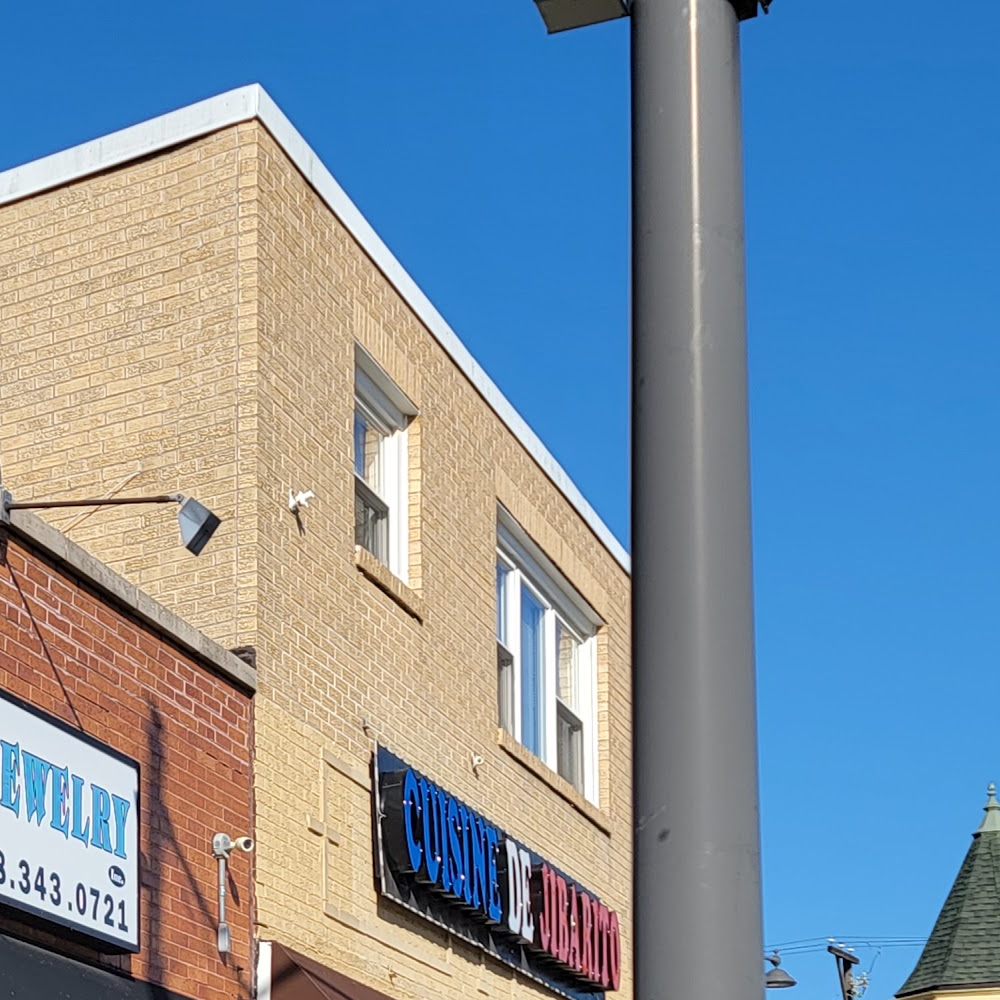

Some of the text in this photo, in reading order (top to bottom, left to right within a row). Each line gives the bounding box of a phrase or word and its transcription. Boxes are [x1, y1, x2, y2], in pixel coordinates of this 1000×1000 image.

[403, 767, 621, 992] CUISINE DE JIBARITO
